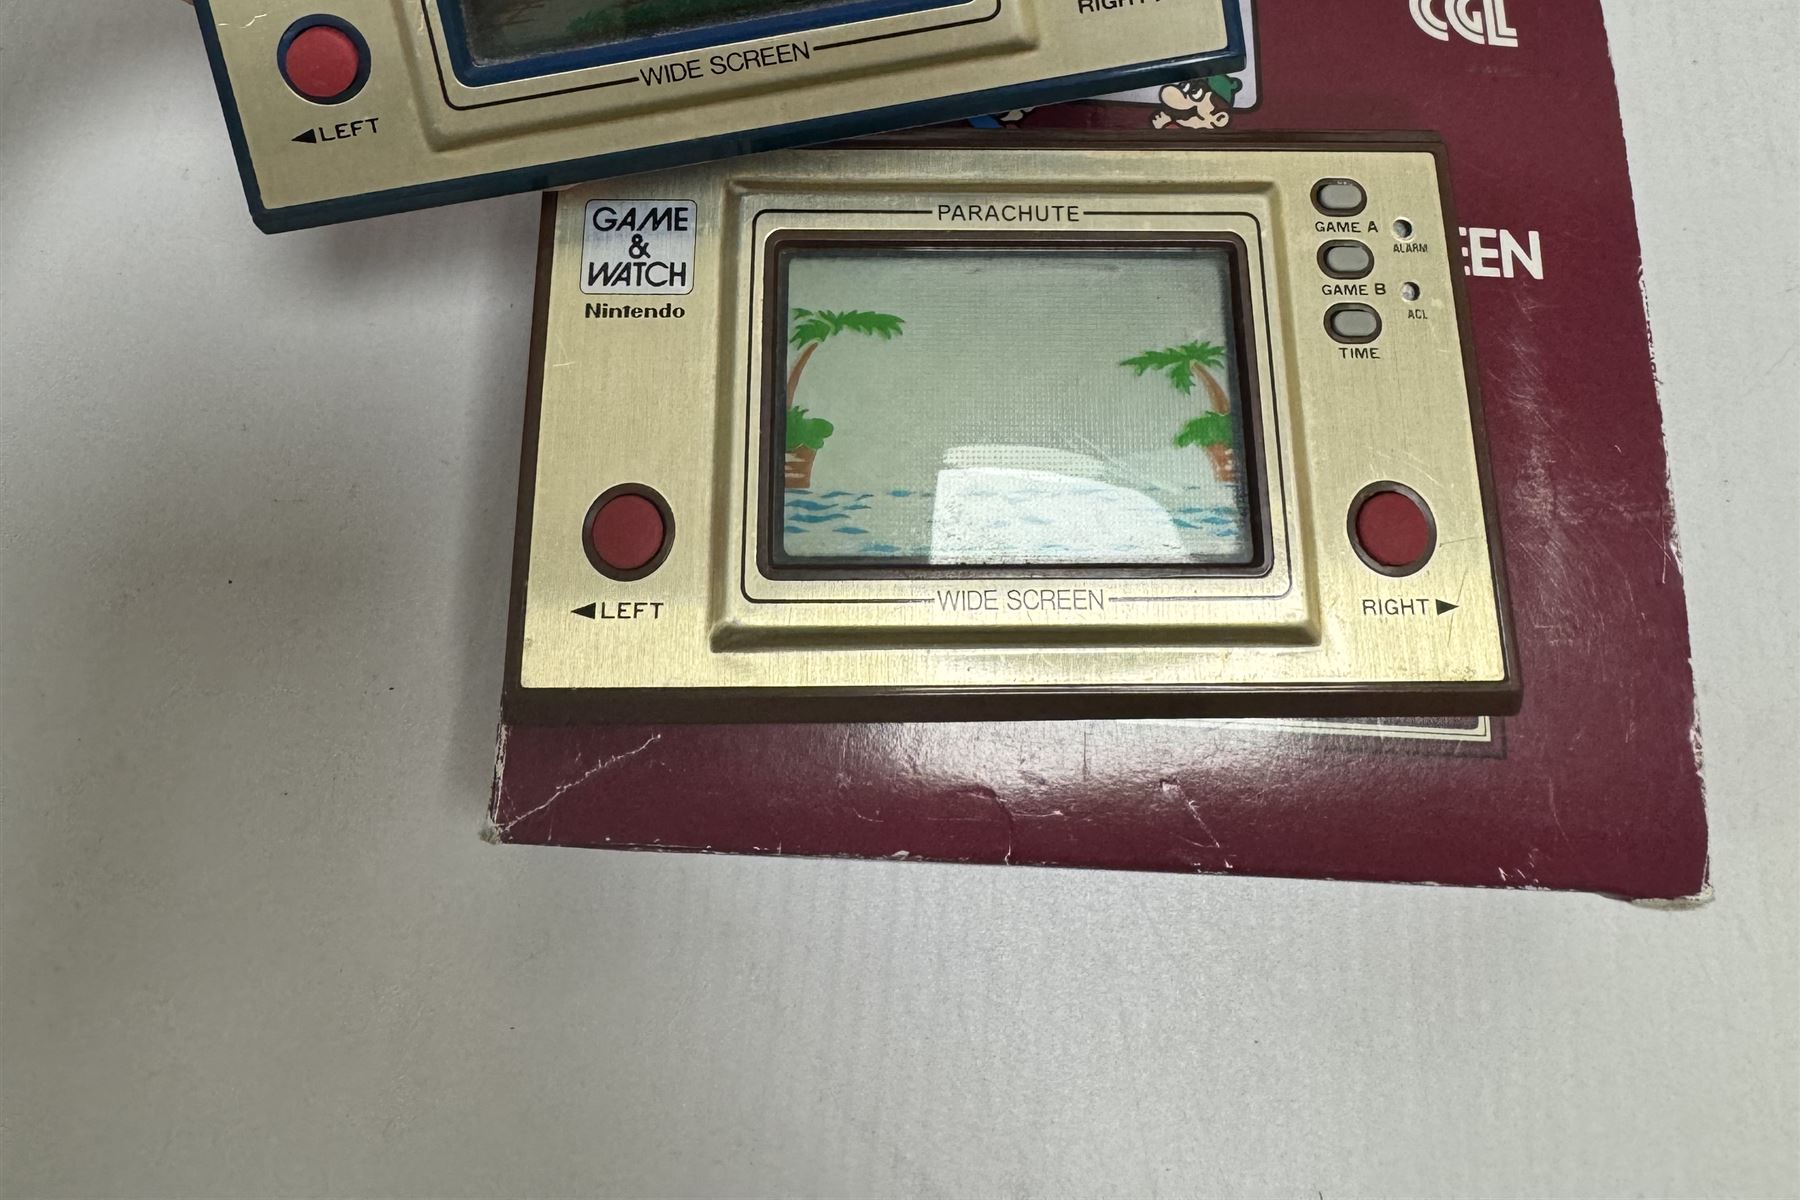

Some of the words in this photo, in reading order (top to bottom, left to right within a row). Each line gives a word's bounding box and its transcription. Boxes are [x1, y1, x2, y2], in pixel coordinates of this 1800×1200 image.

[639, 59, 704, 86] WIDE
[709, 41, 810, 75] SCREEN
[318, 117, 379, 142] LEFT
[592, 206, 689, 232] GAME
[938, 204, 1080, 222] PARACHUTE
[1315, 221, 1361, 233] GAME
[1367, 220, 1379, 233] A
[628, 233, 651, 259] &
[1393, 243, 1428, 254] ALARM
[587, 261, 687, 287] WATCH
[1321, 284, 1368, 296] GAME
[1375, 283, 1386, 295] B
[585, 303, 685, 318] Nintendo
[1408, 309, 1428, 320] ACL
[1339, 347, 1381, 360] TIME
[937, 589, 999, 611] WIDE
[1007, 589, 1104, 611] SCREEN
[1362, 598, 1430, 616] RIGHT
[601, 601, 664, 619] LEFT
